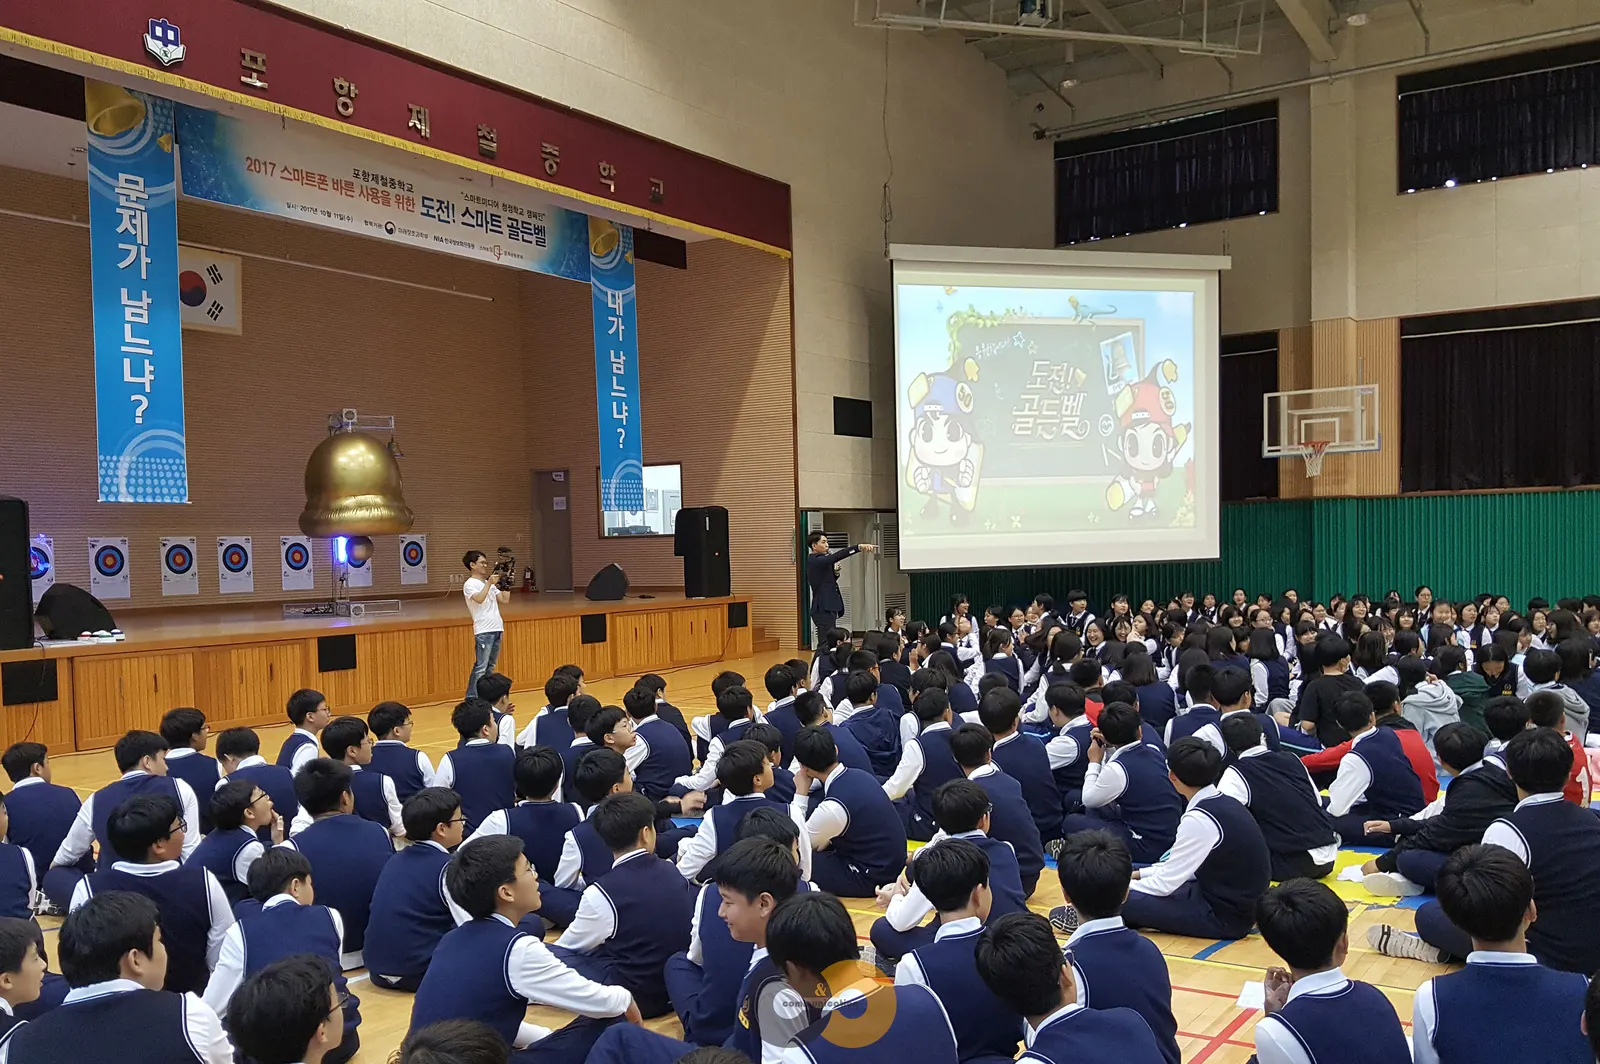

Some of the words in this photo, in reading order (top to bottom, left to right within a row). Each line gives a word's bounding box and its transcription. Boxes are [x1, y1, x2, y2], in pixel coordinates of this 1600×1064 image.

[245, 156, 276, 177] 2017
[279, 165, 329, 192] 스마트폰
[331, 177, 355, 198] 바른
[358, 185, 391, 207] 사용을
[394, 193, 416, 213] 위한
[420, 195, 456, 224] 도전!
[461, 206, 503, 235] 스마트
[507, 216, 547, 248] 골든벨
[353, 168, 415, 193] 포항제철중학교
[115, 172, 151, 280] 문제가
[300, 205, 318, 216] 2017년
[434, 235, 444, 243] NIA
[607, 291, 625, 341] 내가
[121, 287, 155, 424] 남느냐?
[1026, 360, 1074, 395] 도전!
[610, 350, 628, 449] 남느냐?
[1012, 392, 1091, 441] 골든벨
